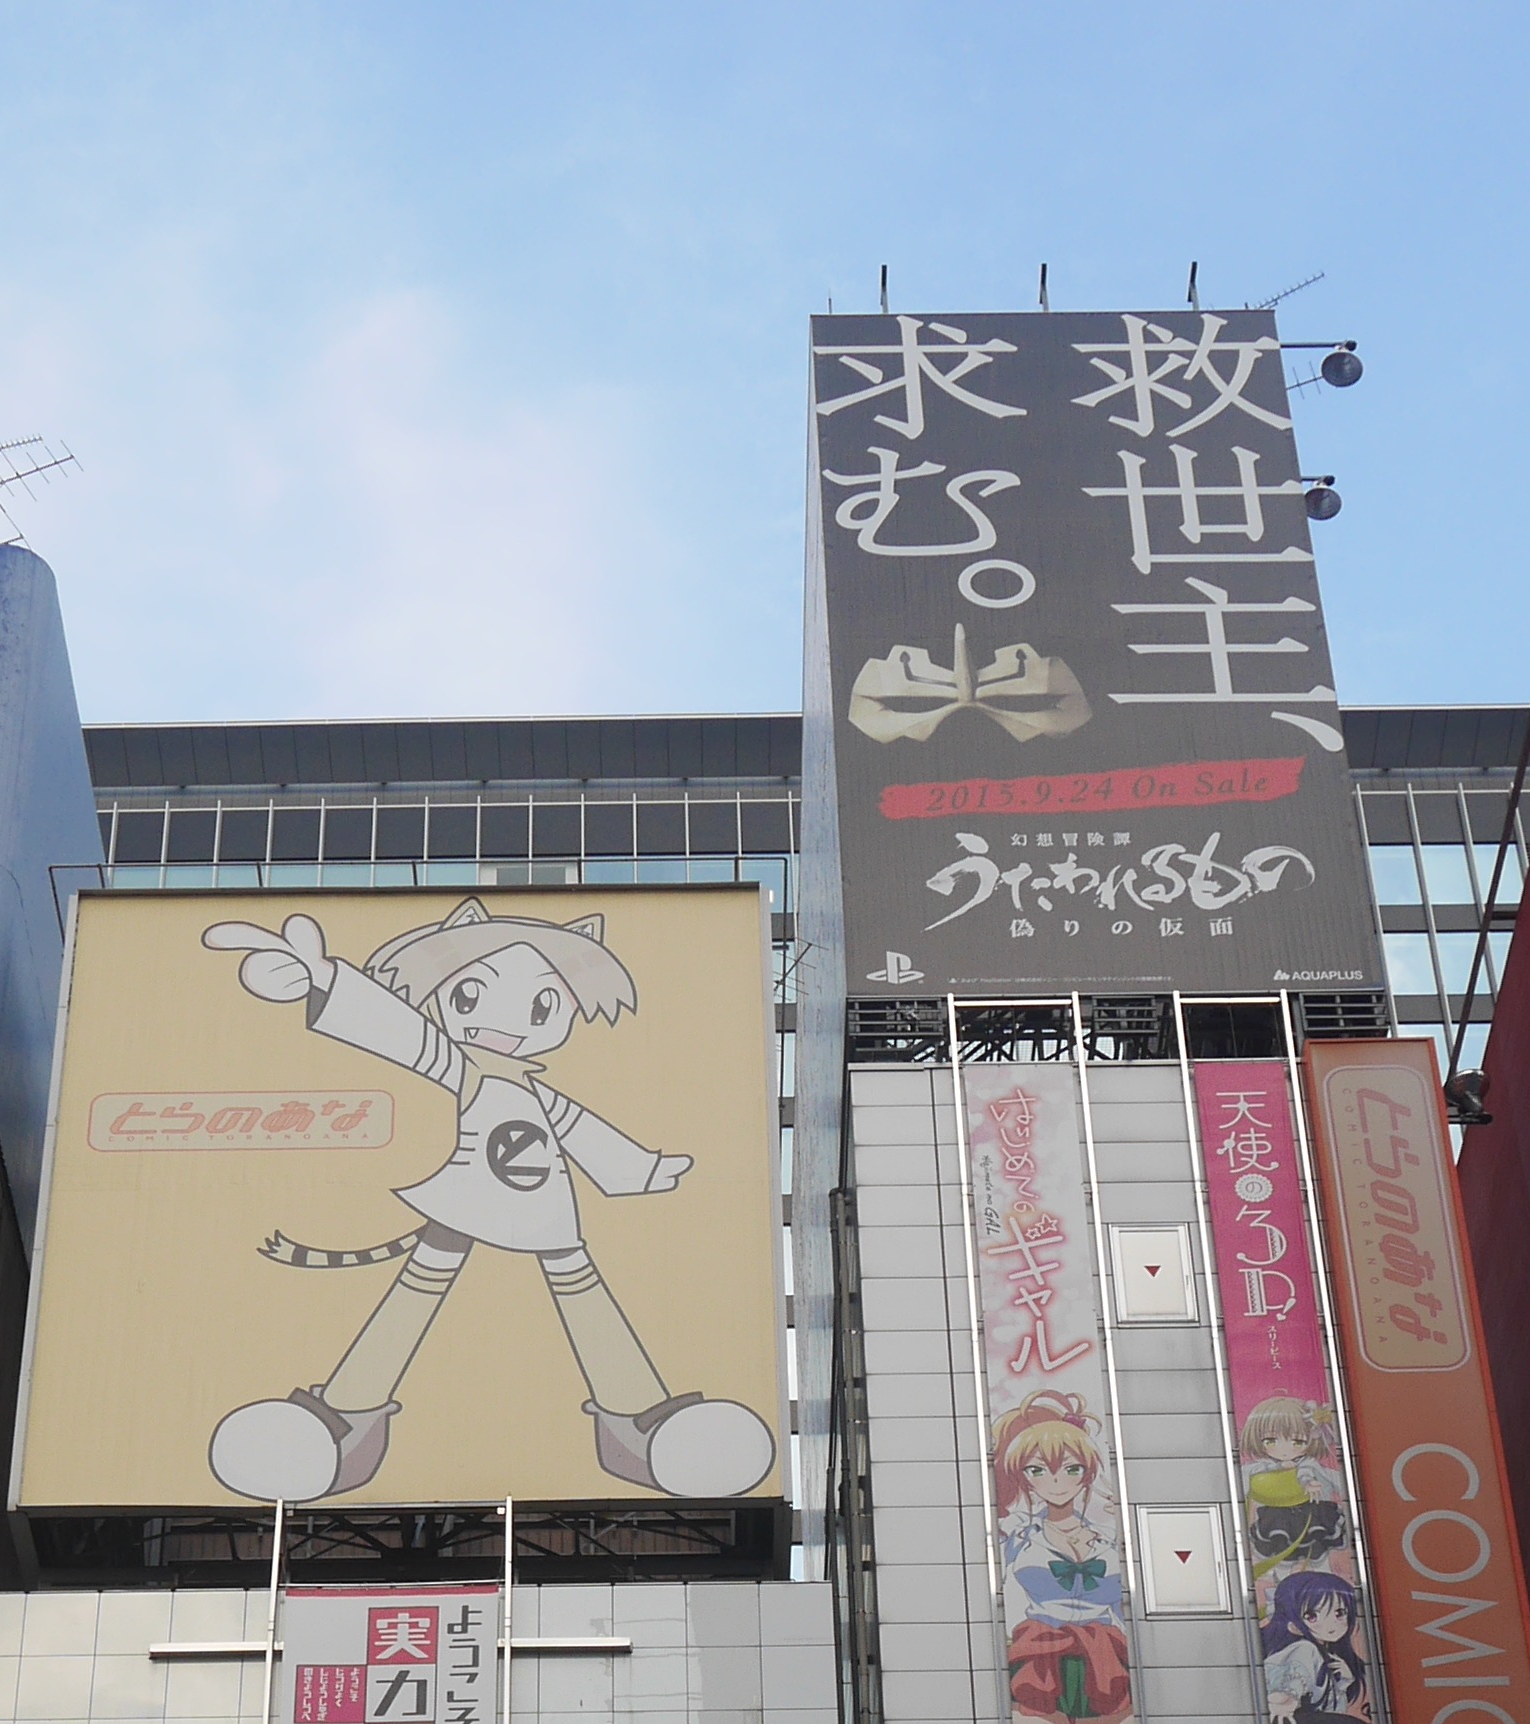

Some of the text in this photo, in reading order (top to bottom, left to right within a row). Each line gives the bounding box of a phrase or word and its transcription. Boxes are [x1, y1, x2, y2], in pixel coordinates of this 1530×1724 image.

[812, 314, 1036, 609] 求む。
[1070, 312, 1345, 752] 救世主、
[928, 769, 1269, 813] 2015.9.24 On Sale
[1011, 831, 1131, 847] 幻想冒険譚
[921, 831, 1316, 933] うたわれるもの
[1010, 916, 1234, 937] 偽りの仮面
[1292, 969, 1364, 982] AQUAPLUS
[109, 1100, 373, 1135] とらのあな
[109, 1132, 369, 1142] COMIC TORANOANA
[983, 1207, 1002, 1235] GAL
[1342, 1087, 1388, 1344] COMIC TORANOANA
[1356, 1087, 1449, 1346] とらのあな
[1268, 1325, 1281, 1369] スリーピース
